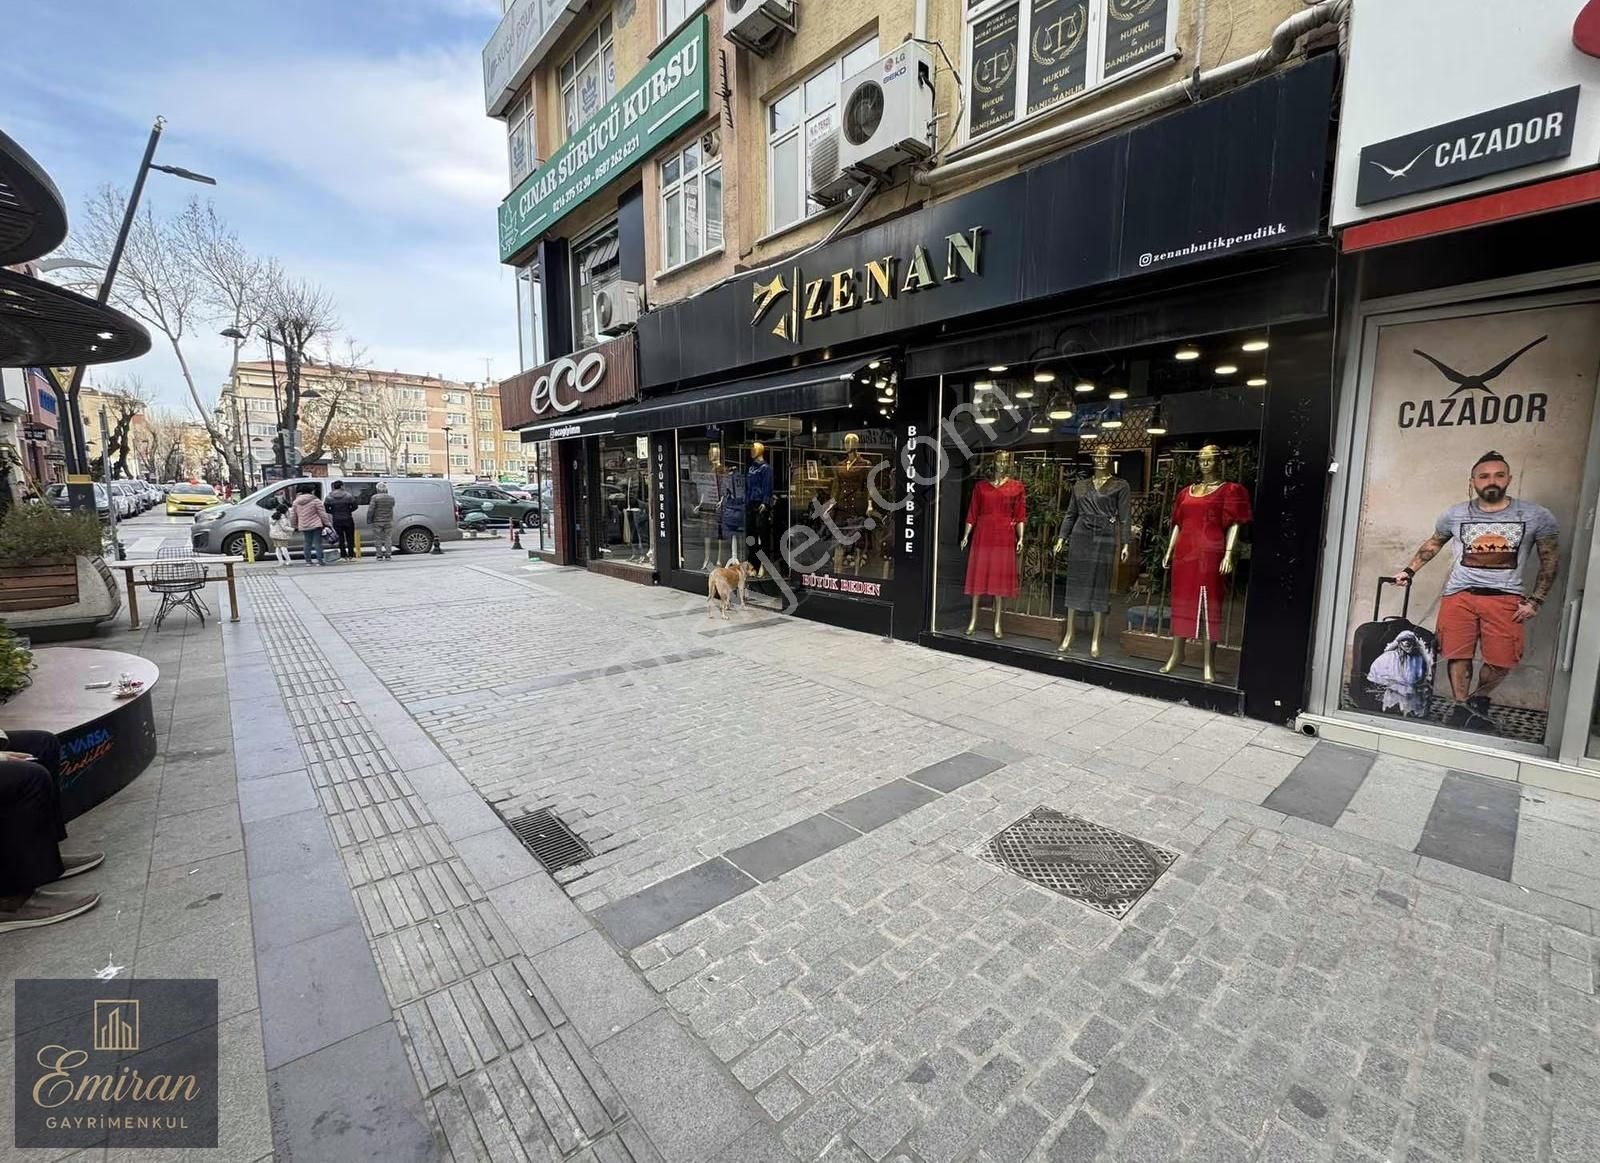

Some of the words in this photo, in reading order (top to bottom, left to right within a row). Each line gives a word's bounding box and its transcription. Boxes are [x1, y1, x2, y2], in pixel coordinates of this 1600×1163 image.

[1120, 20, 1150, 41] HUKUK
[895, 52, 906, 65] LG
[1104, 36, 1165, 71] DANIŞMANLIK
[1042, 66, 1071, 86] HUKUK
[982, 95, 1005, 111] HUKUK
[519, 167, 558, 223] ÇINAR
[558, 102, 620, 185] SÜRÜCÜ
[622, 35, 700, 131] KURSU
[970, 110, 1014, 134] DANIŞMANLIK
[1434, 111, 1564, 168] CAZADOR
[610, 148, 623, 168] 262
[623, 133, 640, 157] 6231
[1153, 223, 1287, 263] zenanbutikpendikk
[804, 226, 983, 321] ZENAN
[1398, 392, 1549, 429] CAZADOR
[906, 425, 917, 493] BÜYÜK
[802, 572, 838, 591] BÜYÜK
[840, 579, 881, 597] BEDEN
